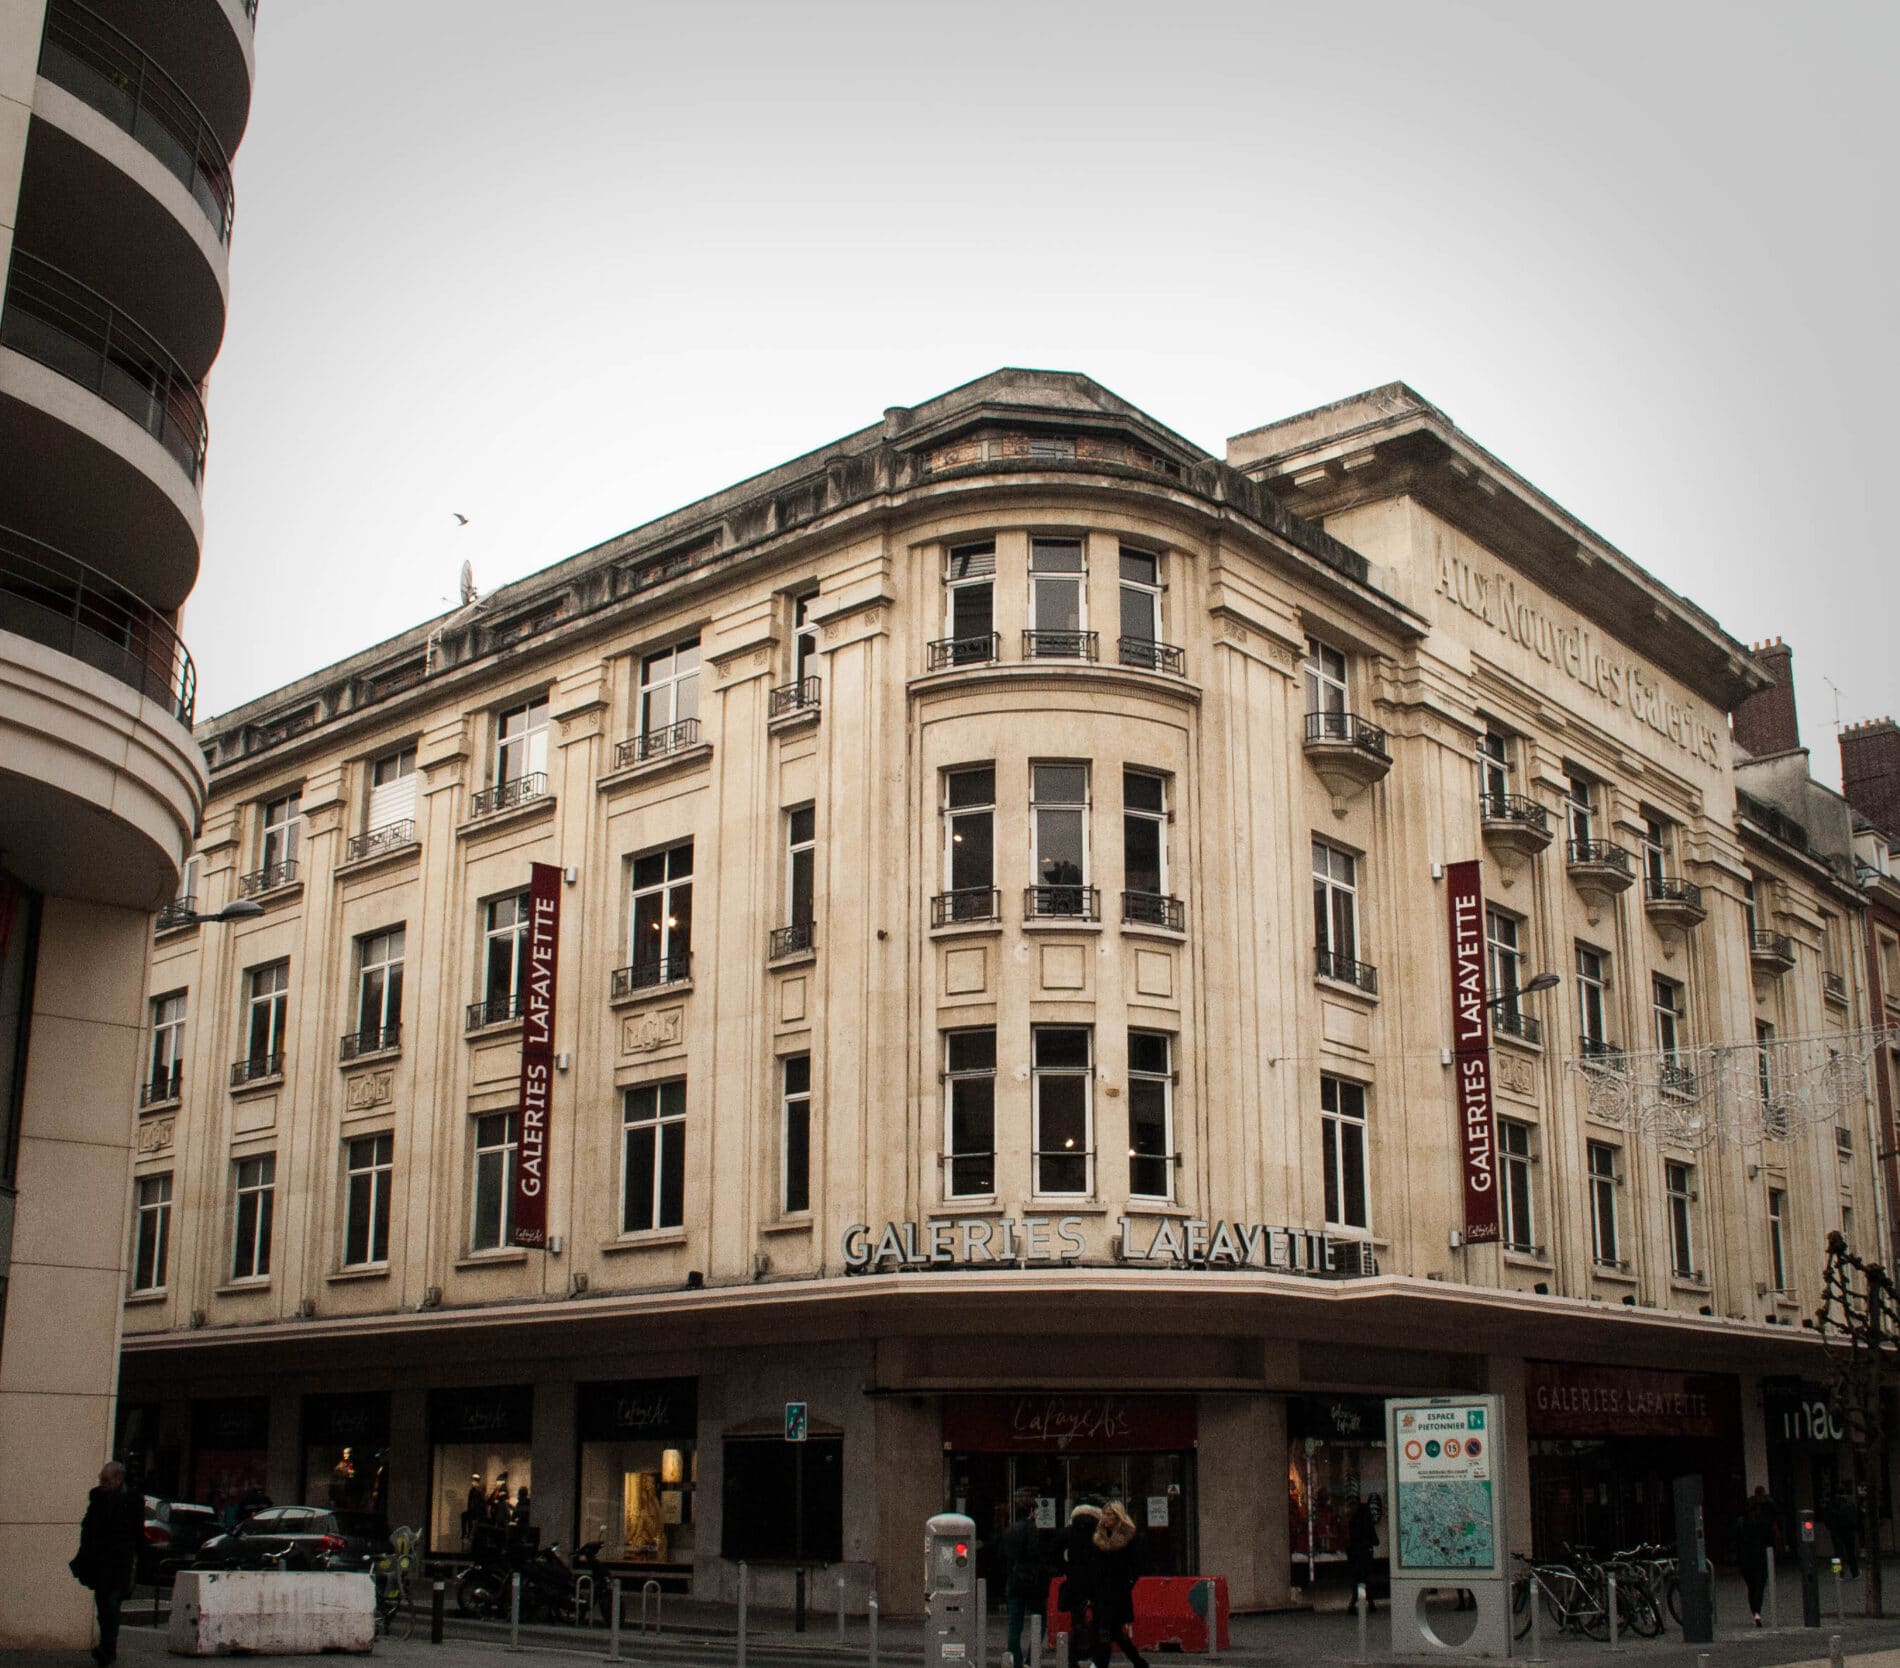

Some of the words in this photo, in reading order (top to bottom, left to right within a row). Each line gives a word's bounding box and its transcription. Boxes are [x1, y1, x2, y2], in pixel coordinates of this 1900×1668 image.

[529, 897, 555, 1044] LAFAYETTE
[1455, 893, 1481, 1041] LAFAYETTE
[521, 1063, 547, 1197] GALERIES
[1463, 1058, 1490, 1193] GALERIES
[841, 1216, 1086, 1269] GALERIES
[1118, 1216, 1336, 1271] LAFAYETTE
[1427, 1413, 1455, 1421] ESPACE
[1536, 1385, 1619, 1413] GALERIES
[1626, 1389, 1708, 1417] LAFAYETTE
[1448, 1444, 1457, 1453] 15
